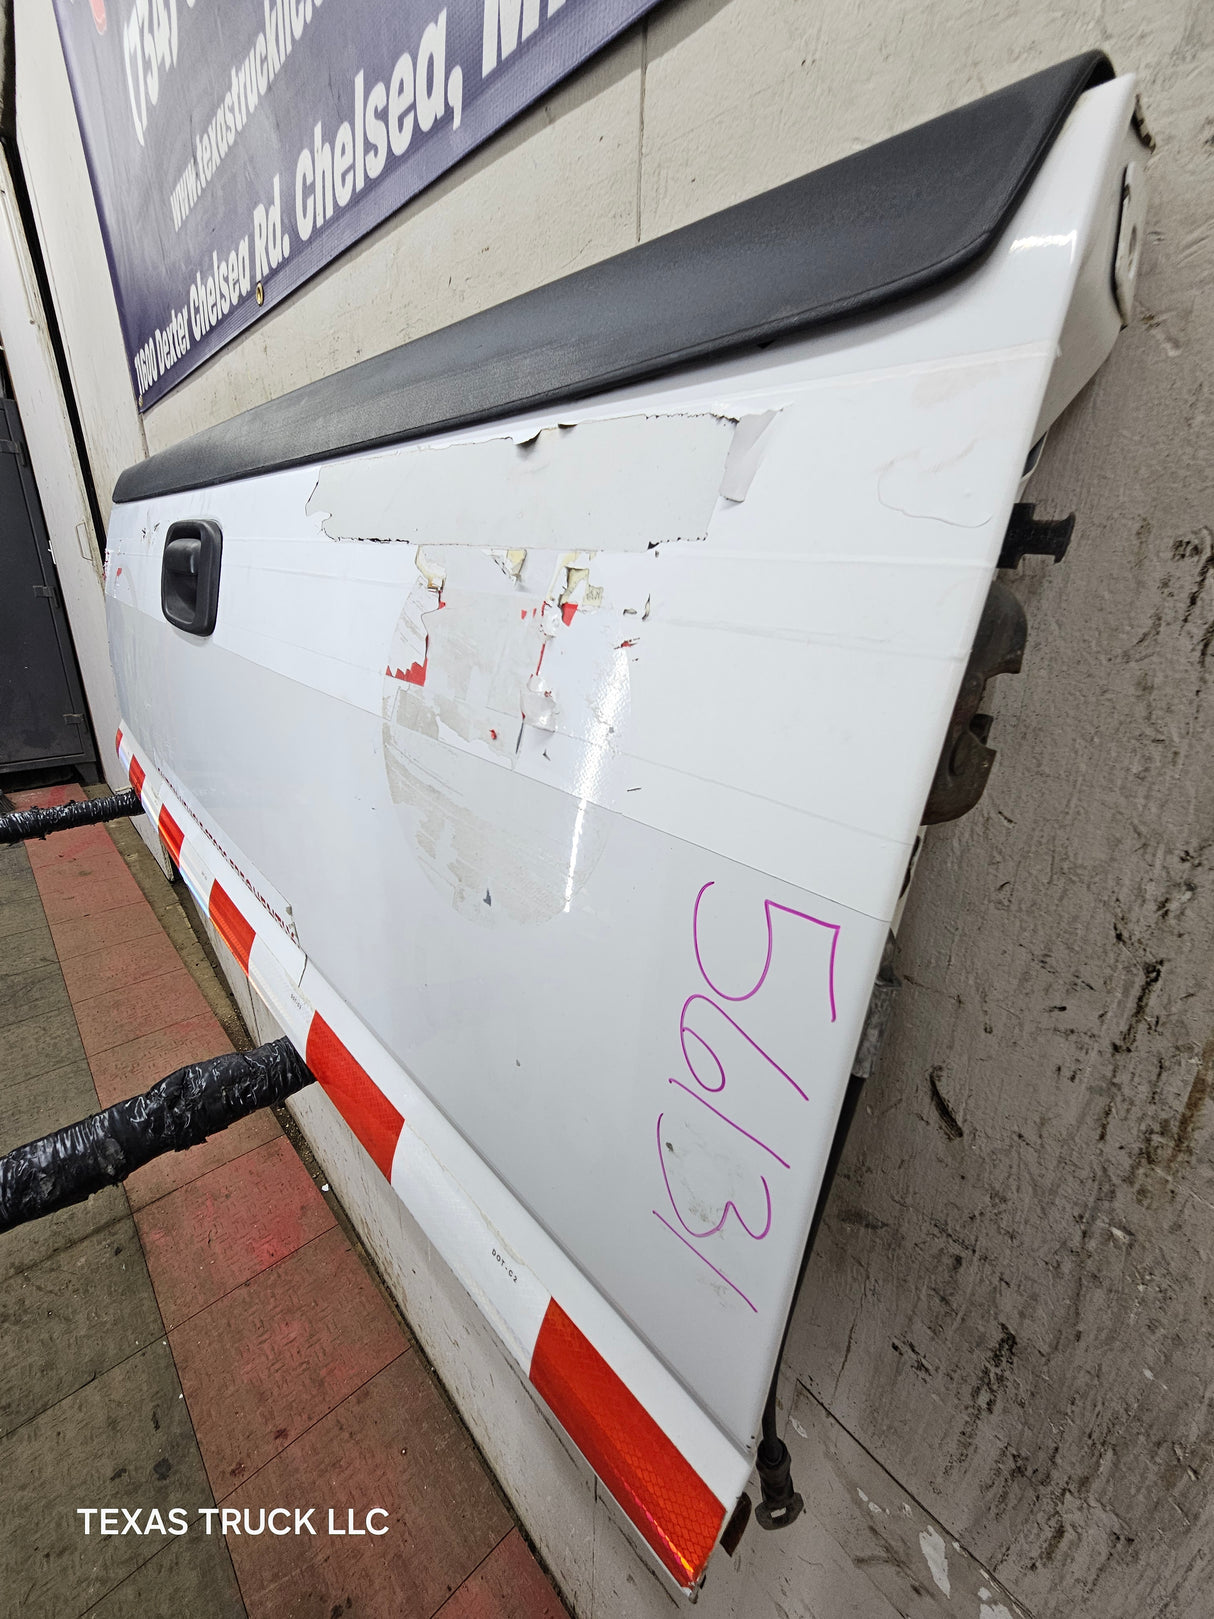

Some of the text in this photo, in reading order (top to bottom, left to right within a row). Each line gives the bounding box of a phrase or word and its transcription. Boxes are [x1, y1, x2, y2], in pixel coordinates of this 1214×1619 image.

[134, 7, 463, 395] 11600 Dexter Chelsea Rd. Chelsea,
[491, 1248, 518, 1283] DOT-C2
